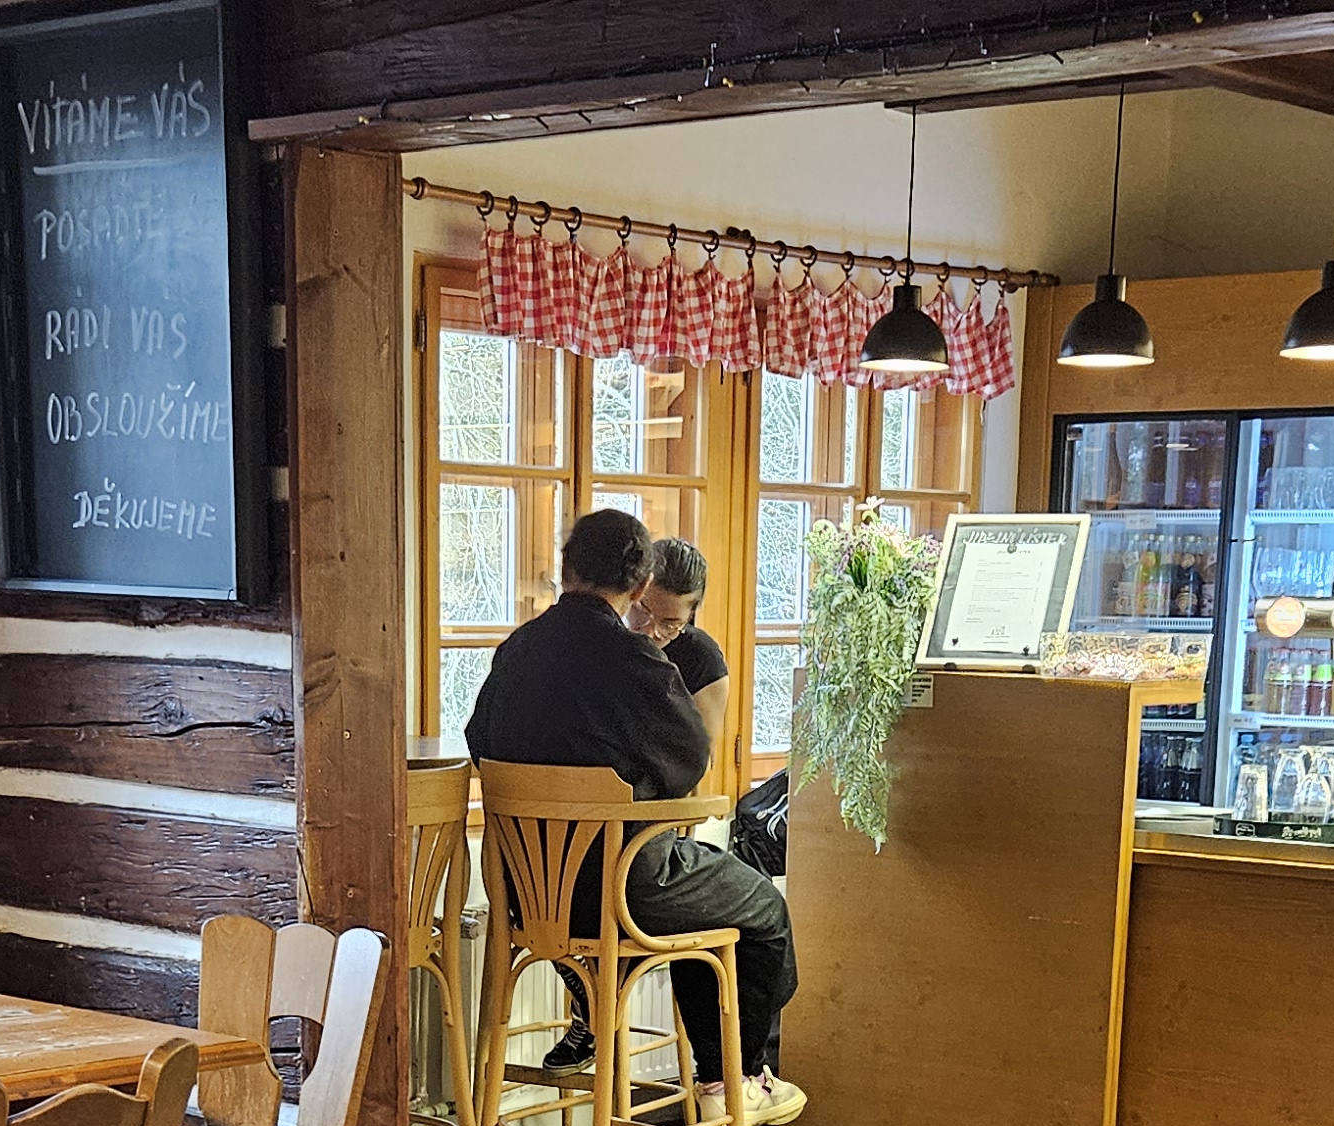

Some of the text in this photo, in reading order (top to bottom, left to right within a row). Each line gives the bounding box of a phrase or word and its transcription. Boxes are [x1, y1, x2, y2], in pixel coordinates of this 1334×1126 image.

[17, 61, 212, 154] VÍTÁME VÁS
[46, 286, 111, 360] RÁDI
[46, 381, 230, 444] OBSLOUŽÍME
[72, 478, 218, 540] DĚKUJEME
